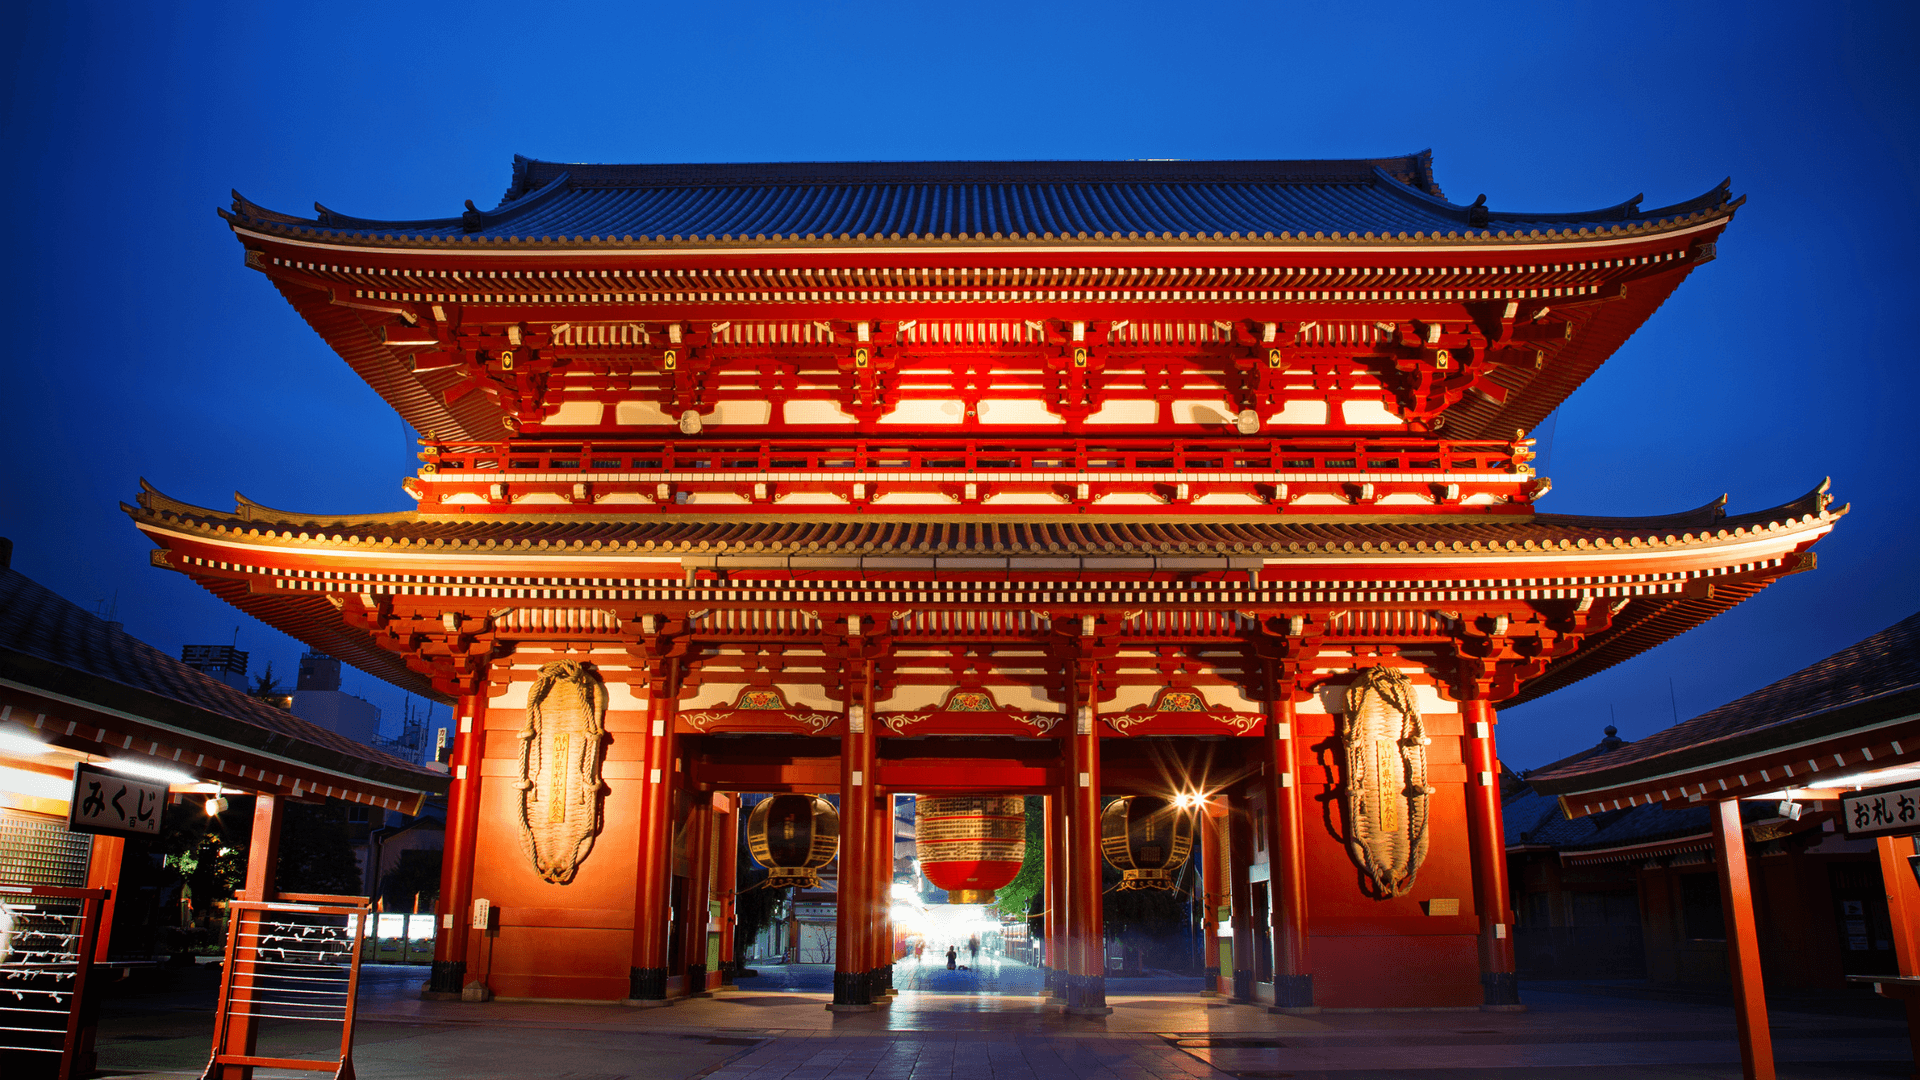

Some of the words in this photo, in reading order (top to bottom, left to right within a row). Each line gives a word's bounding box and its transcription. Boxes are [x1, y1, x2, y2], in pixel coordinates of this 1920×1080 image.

[82, 781, 156, 822] みくじ
[1854, 794, 1920, 829] お札お
